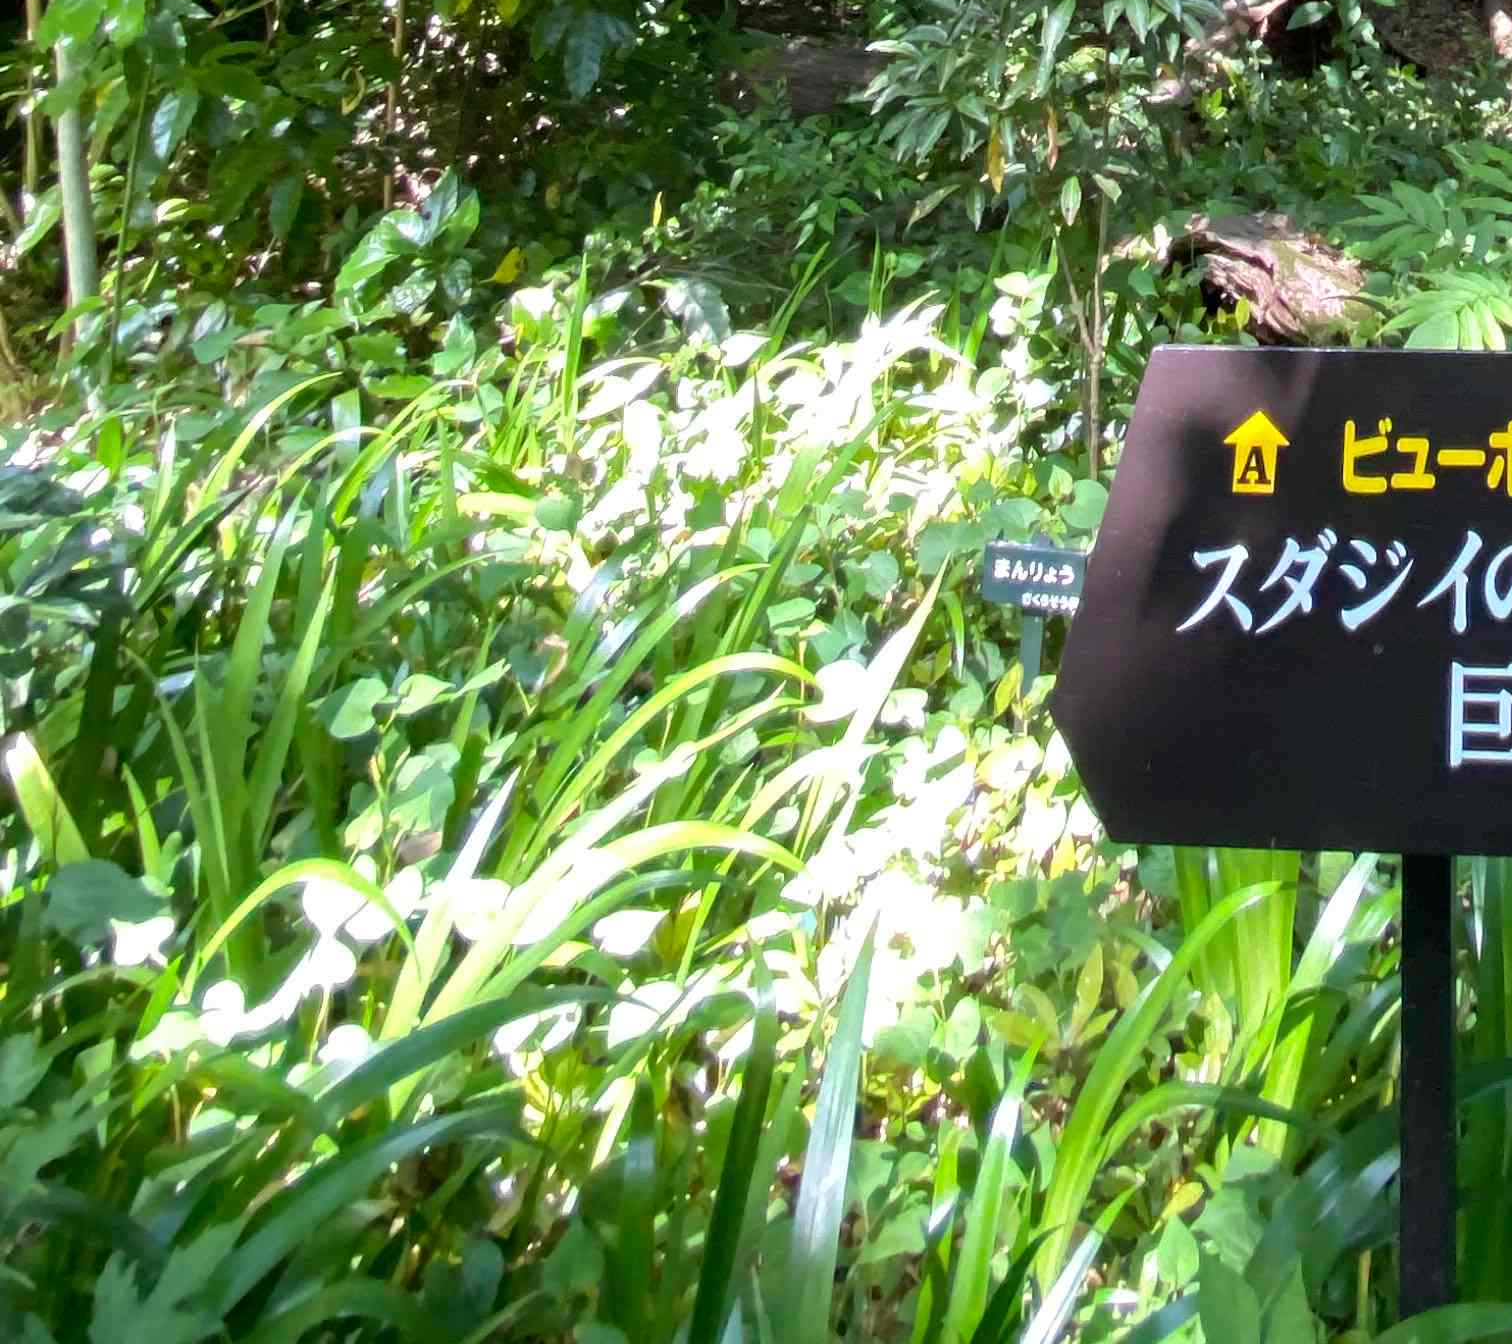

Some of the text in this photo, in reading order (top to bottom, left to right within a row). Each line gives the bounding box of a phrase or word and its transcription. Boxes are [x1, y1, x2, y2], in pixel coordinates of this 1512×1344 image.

[1238, 445, 1272, 484] A
[993, 558, 1075, 585] まんりょう
